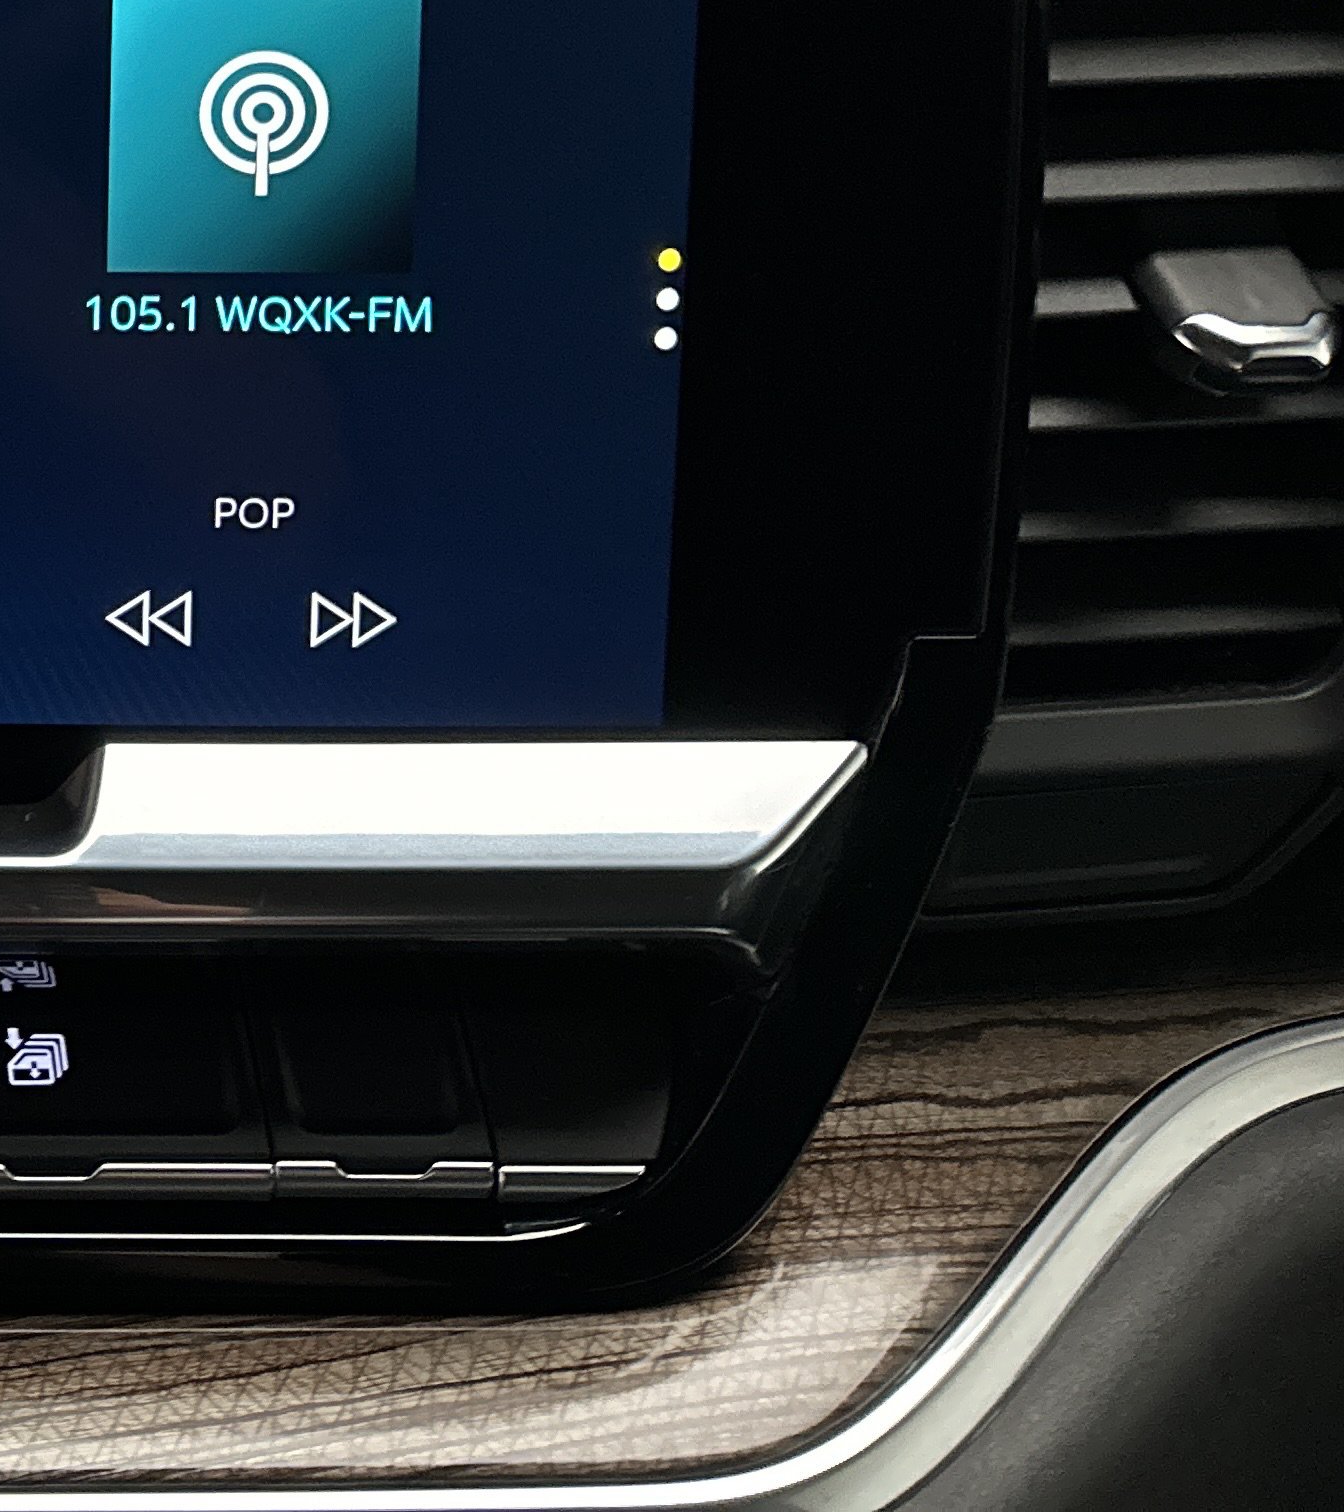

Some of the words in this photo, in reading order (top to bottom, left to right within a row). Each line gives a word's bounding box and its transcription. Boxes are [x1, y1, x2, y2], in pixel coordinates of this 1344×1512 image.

[85, 295, 197, 333] 105.1
[215, 295, 433, 335] WQXK-FM
[214, 496, 295, 529] POP
